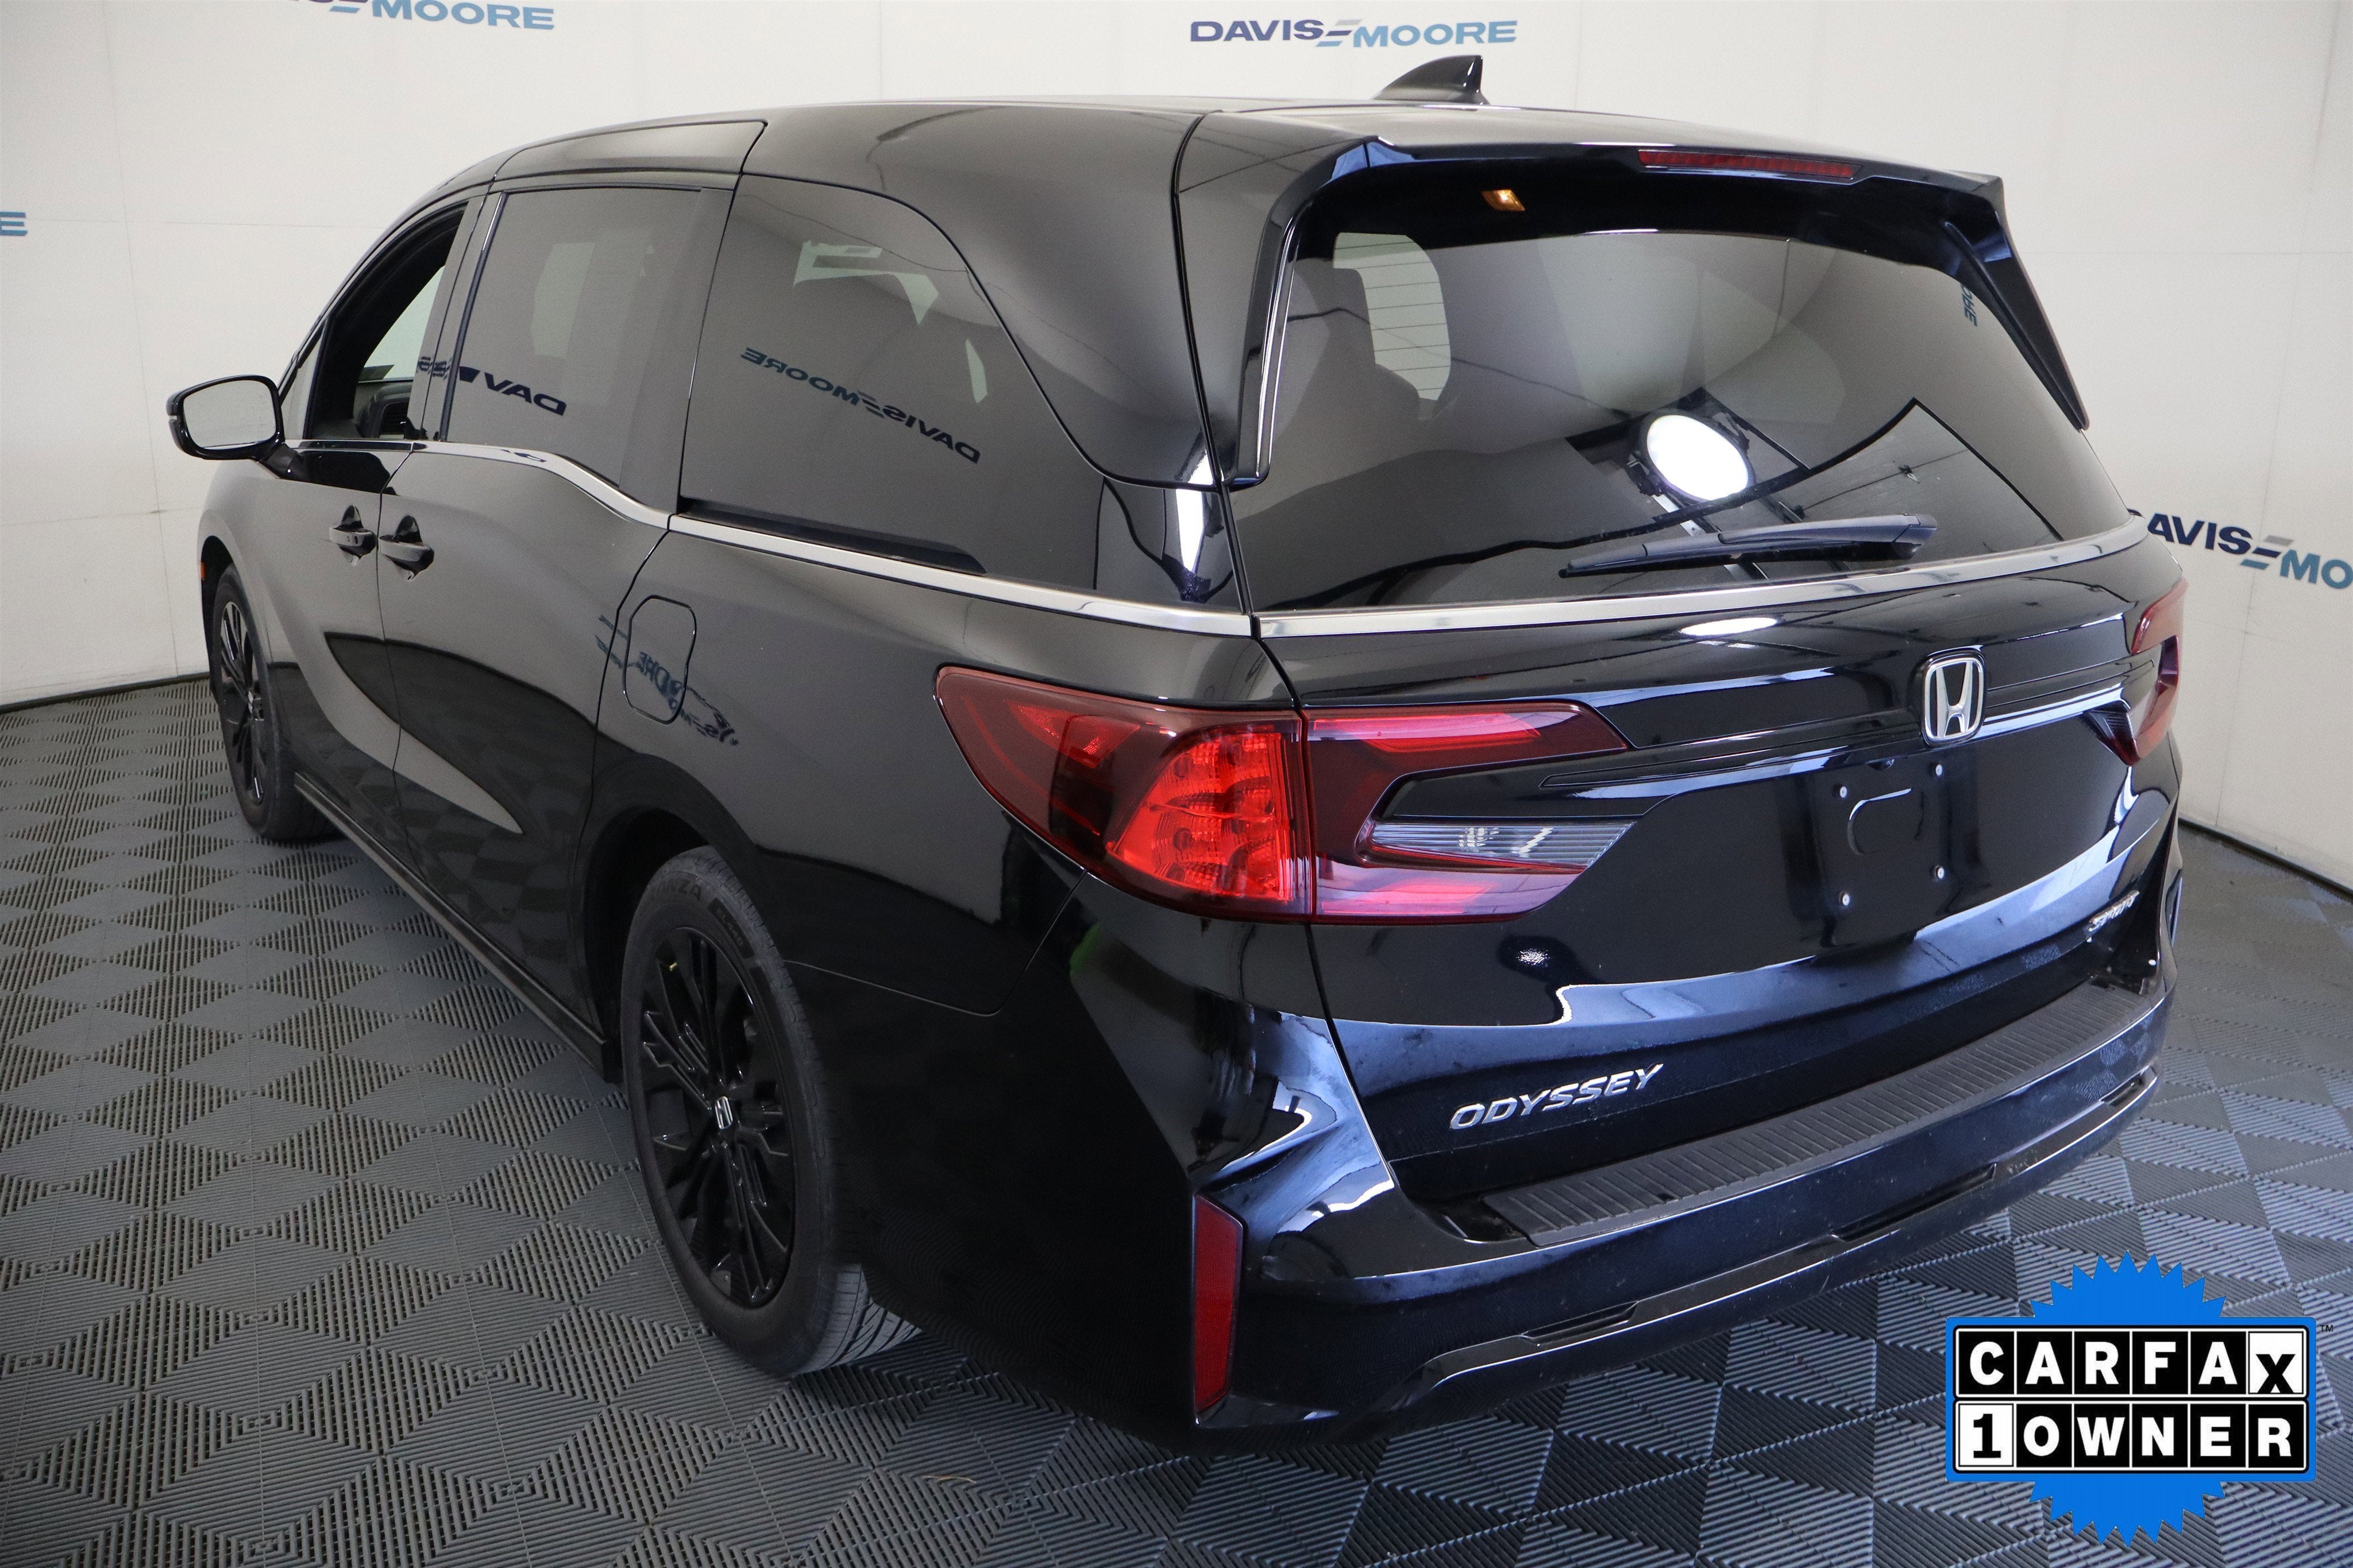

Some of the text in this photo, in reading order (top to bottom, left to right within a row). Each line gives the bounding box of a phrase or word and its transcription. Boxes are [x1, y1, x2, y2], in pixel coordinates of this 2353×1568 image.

[372, 0, 555, 30] MOORE
[1190, 19, 1518, 48] DAVIS MOORE
[2127, 508, 2252, 555] AVIS
[1449, 1063, 1664, 1130] ODYSSEY
